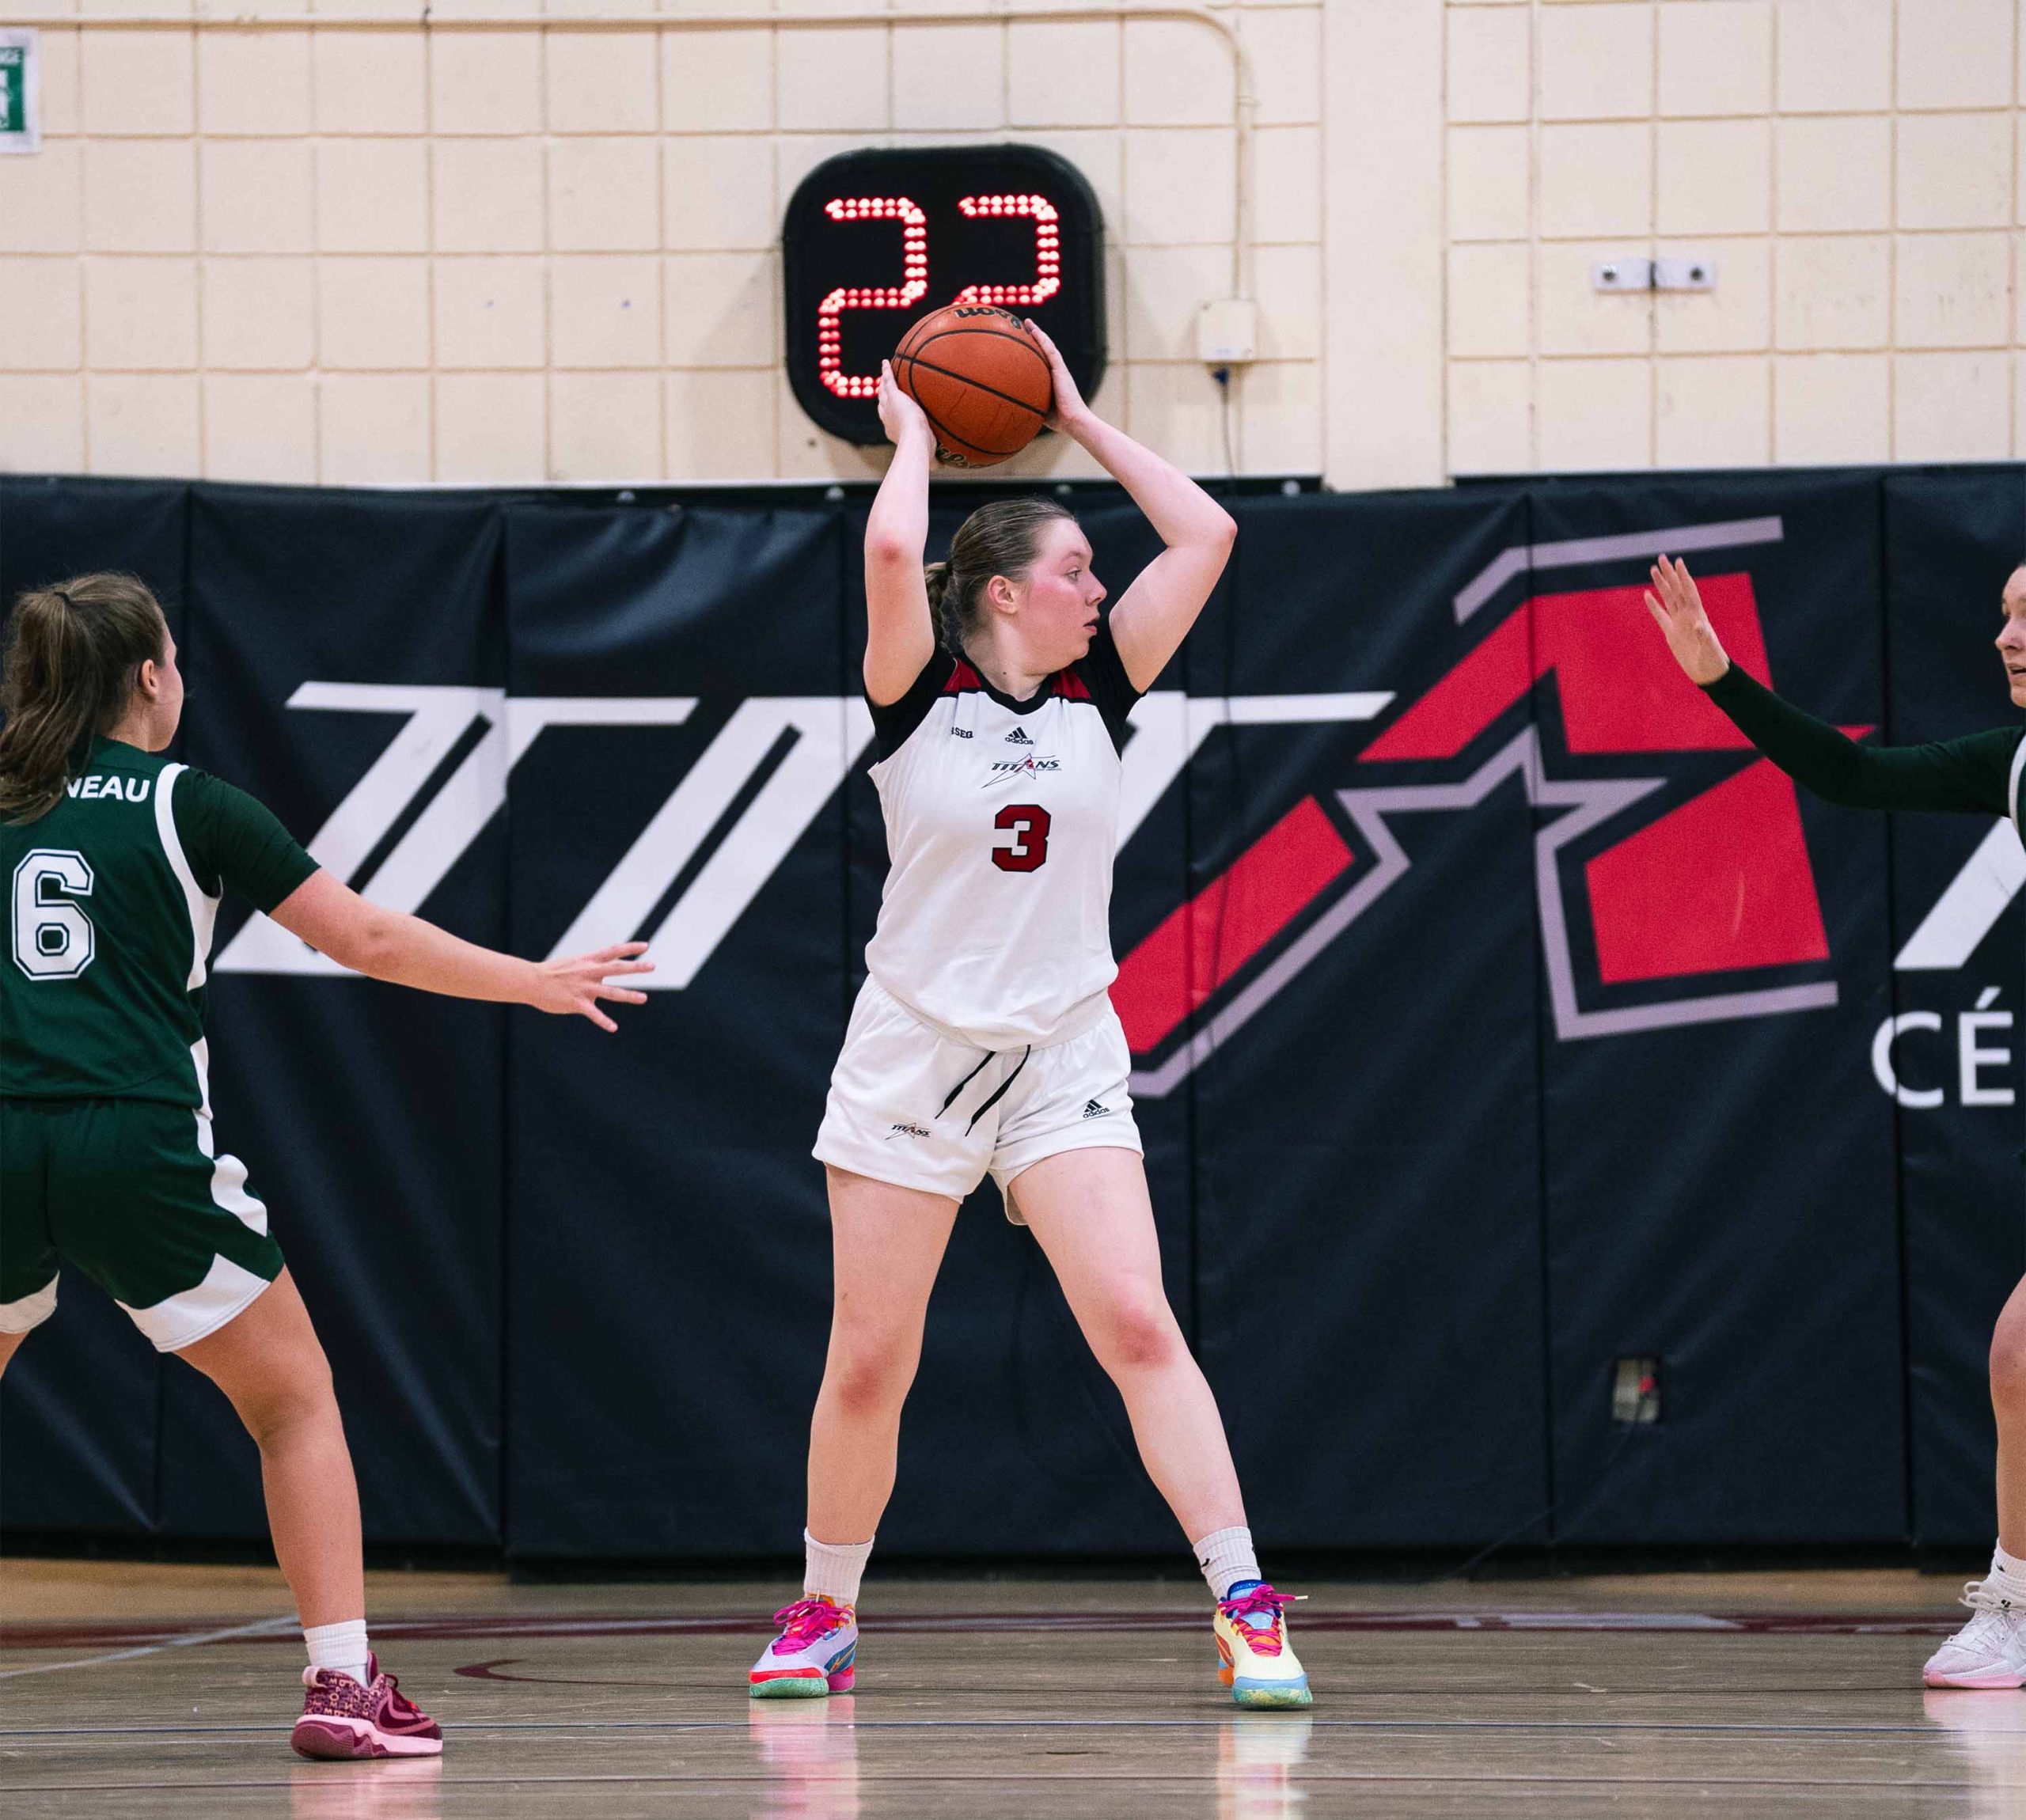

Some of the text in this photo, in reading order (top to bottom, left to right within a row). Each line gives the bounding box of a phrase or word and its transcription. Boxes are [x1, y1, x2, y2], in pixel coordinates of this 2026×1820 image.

[818, 194, 1060, 399] 22
[992, 758, 1060, 773] TITANS
[1004, 736, 1034, 745] adidas
[992, 804, 1051, 873] 3
[12, 848, 95, 980] 6
[1871, 986, 2017, 1108] CÉ
